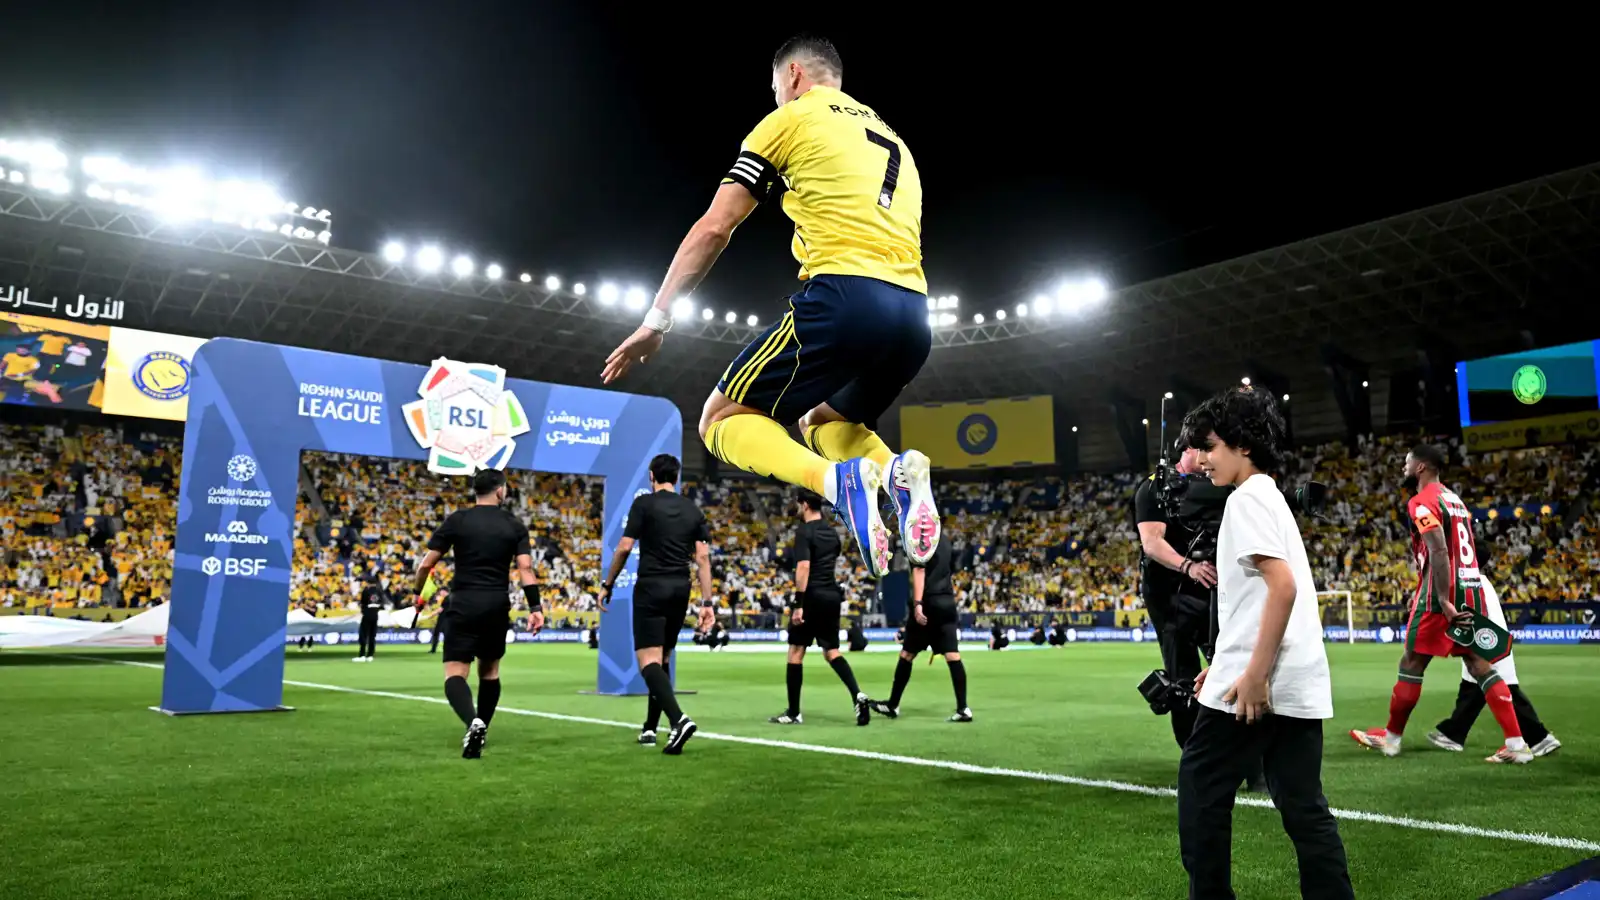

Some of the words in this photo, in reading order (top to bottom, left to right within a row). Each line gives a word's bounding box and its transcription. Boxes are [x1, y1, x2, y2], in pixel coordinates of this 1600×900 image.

[865, 127, 901, 210] 7
[65, 294, 124, 320] الأول
[300, 382, 345, 398] ROSHN
[346, 388, 383, 403] SAUDI
[298, 397, 382, 424] LEAGUE
[449, 406, 488, 429] RSL
[547, 410, 580, 427] روشن
[581, 417, 610, 431] دوري
[546, 430, 609, 447] السعودي
[208, 496, 239, 505] ROSHN
[240, 498, 271, 507] GROUP
[1420, 517, 1430, 527] C
[205, 533, 268, 544] MAADEN
[1457, 522, 1474, 565] 8
[225, 558, 267, 576] BSF
[1537, 629, 1564, 640] SAUDI
[1566, 629, 1600, 640] LEAGUE
